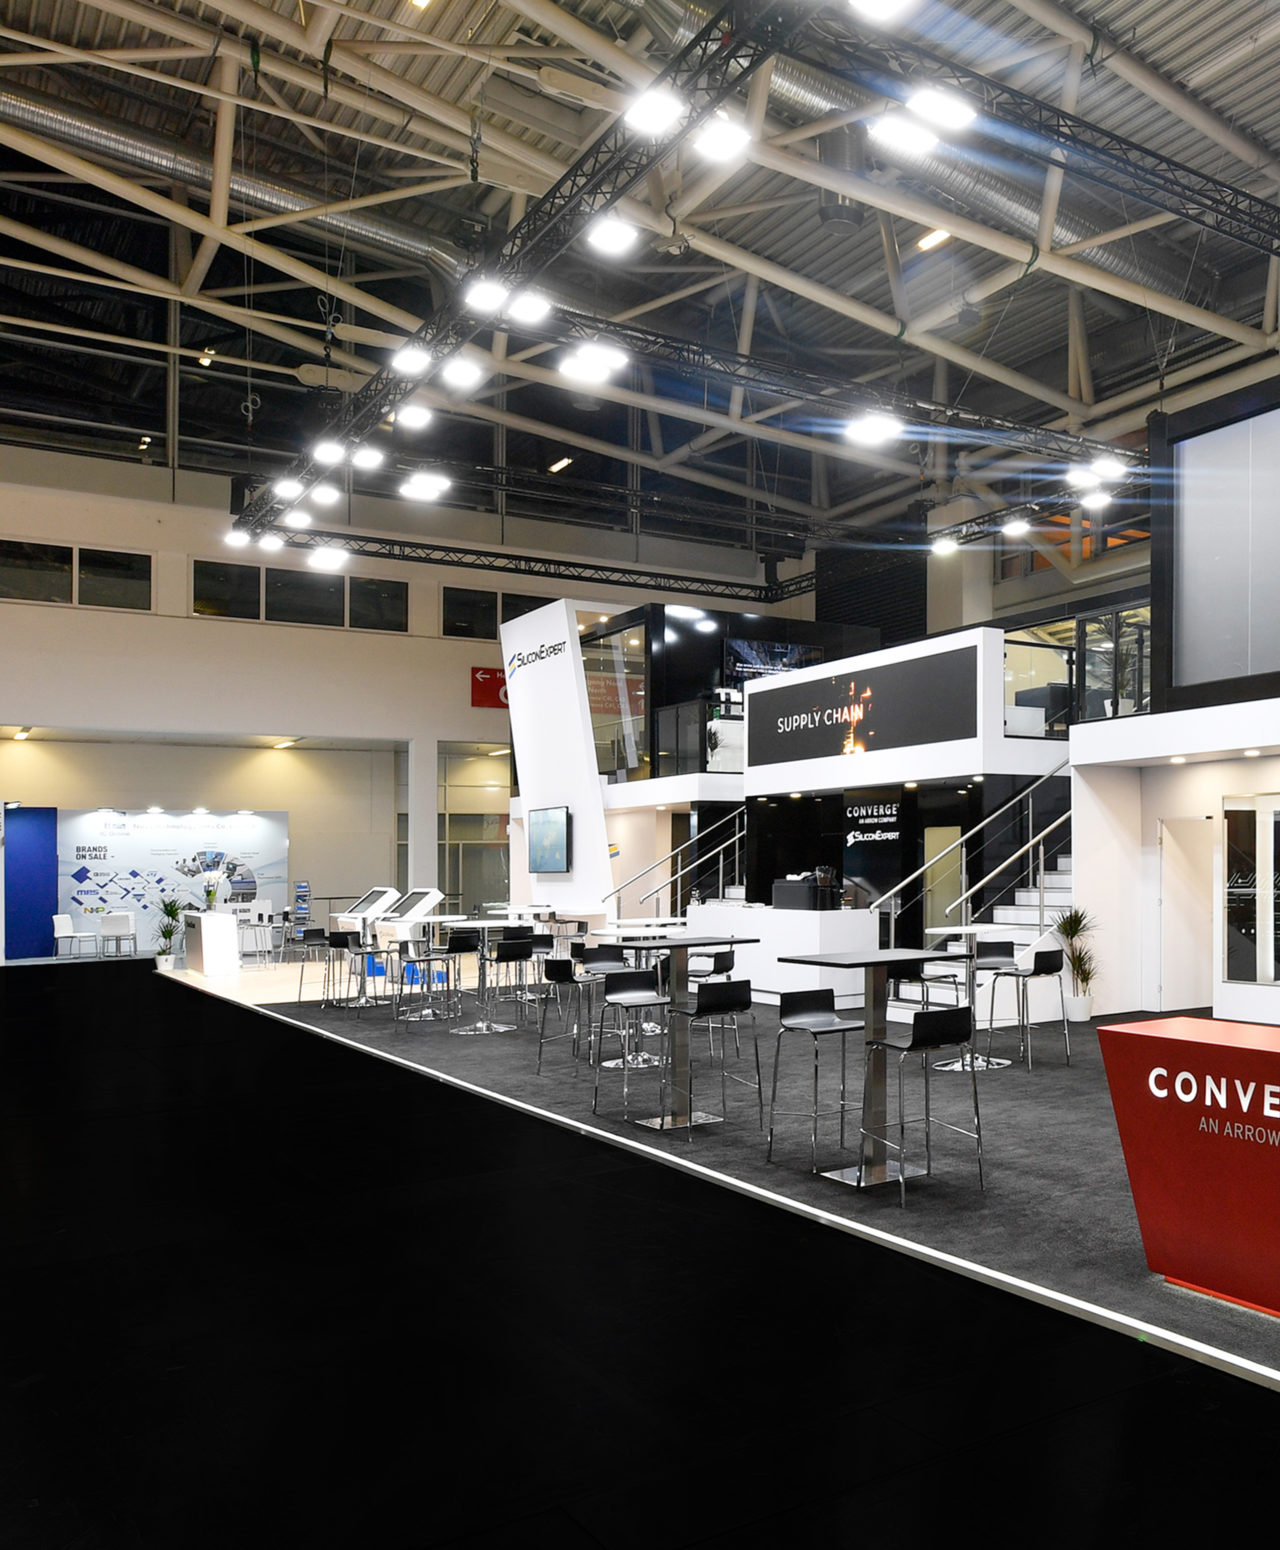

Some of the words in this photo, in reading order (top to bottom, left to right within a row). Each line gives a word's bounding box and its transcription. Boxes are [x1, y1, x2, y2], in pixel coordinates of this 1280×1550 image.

[777, 711, 821, 733] SUPPLY
[824, 704, 864, 727] CHAIN
[1199, 1116, 1219, 1135] AN
[1223, 1121, 1280, 1147] ARROW
